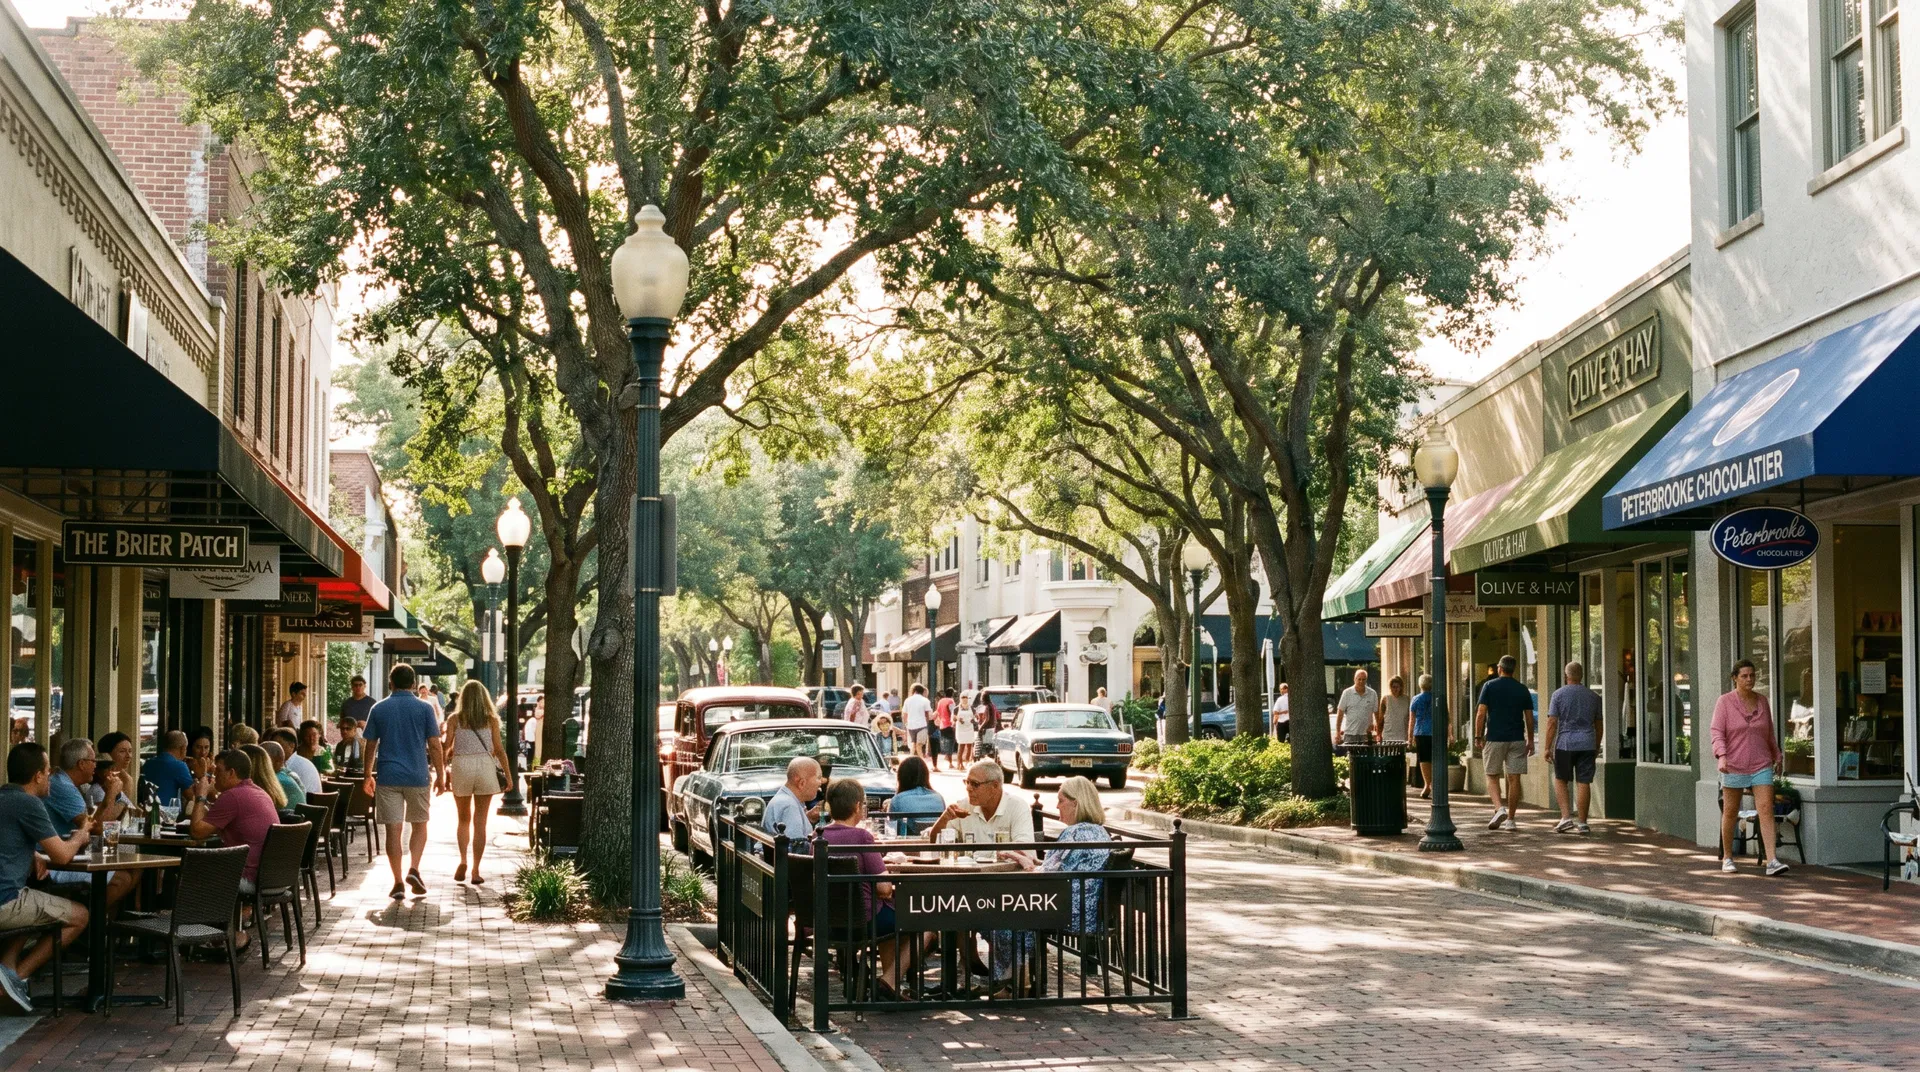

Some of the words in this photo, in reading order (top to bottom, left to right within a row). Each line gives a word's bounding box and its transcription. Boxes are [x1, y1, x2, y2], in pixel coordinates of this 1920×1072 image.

[1569, 352, 1608, 406] OLIVE
[1610, 344, 1621, 385] &
[1624, 325, 1655, 379] HAY
[1621, 477, 1694, 522] PETERBROOKE
[1696, 449, 1783, 500] CHOCOLATIER
[71, 530, 109, 556] THE
[115, 530, 173, 557] BRIER
[180, 532, 238, 558] PATCH
[1483, 538, 1504, 563] OLIVE
[1505, 536, 1511, 557] &
[1512, 530, 1528, 555] HAY
[1723, 516, 1806, 551] Peterbrooke
[1756, 549, 1804, 557] CHOCOLATIER
[1481, 581, 1525, 594] OLIVE
[1529, 581, 1540, 594] &
[1544, 581, 1575, 594] HAY
[909, 894, 972, 913] LUMA
[976, 898, 996, 909] ON
[1001, 893, 1058, 912] PARK
